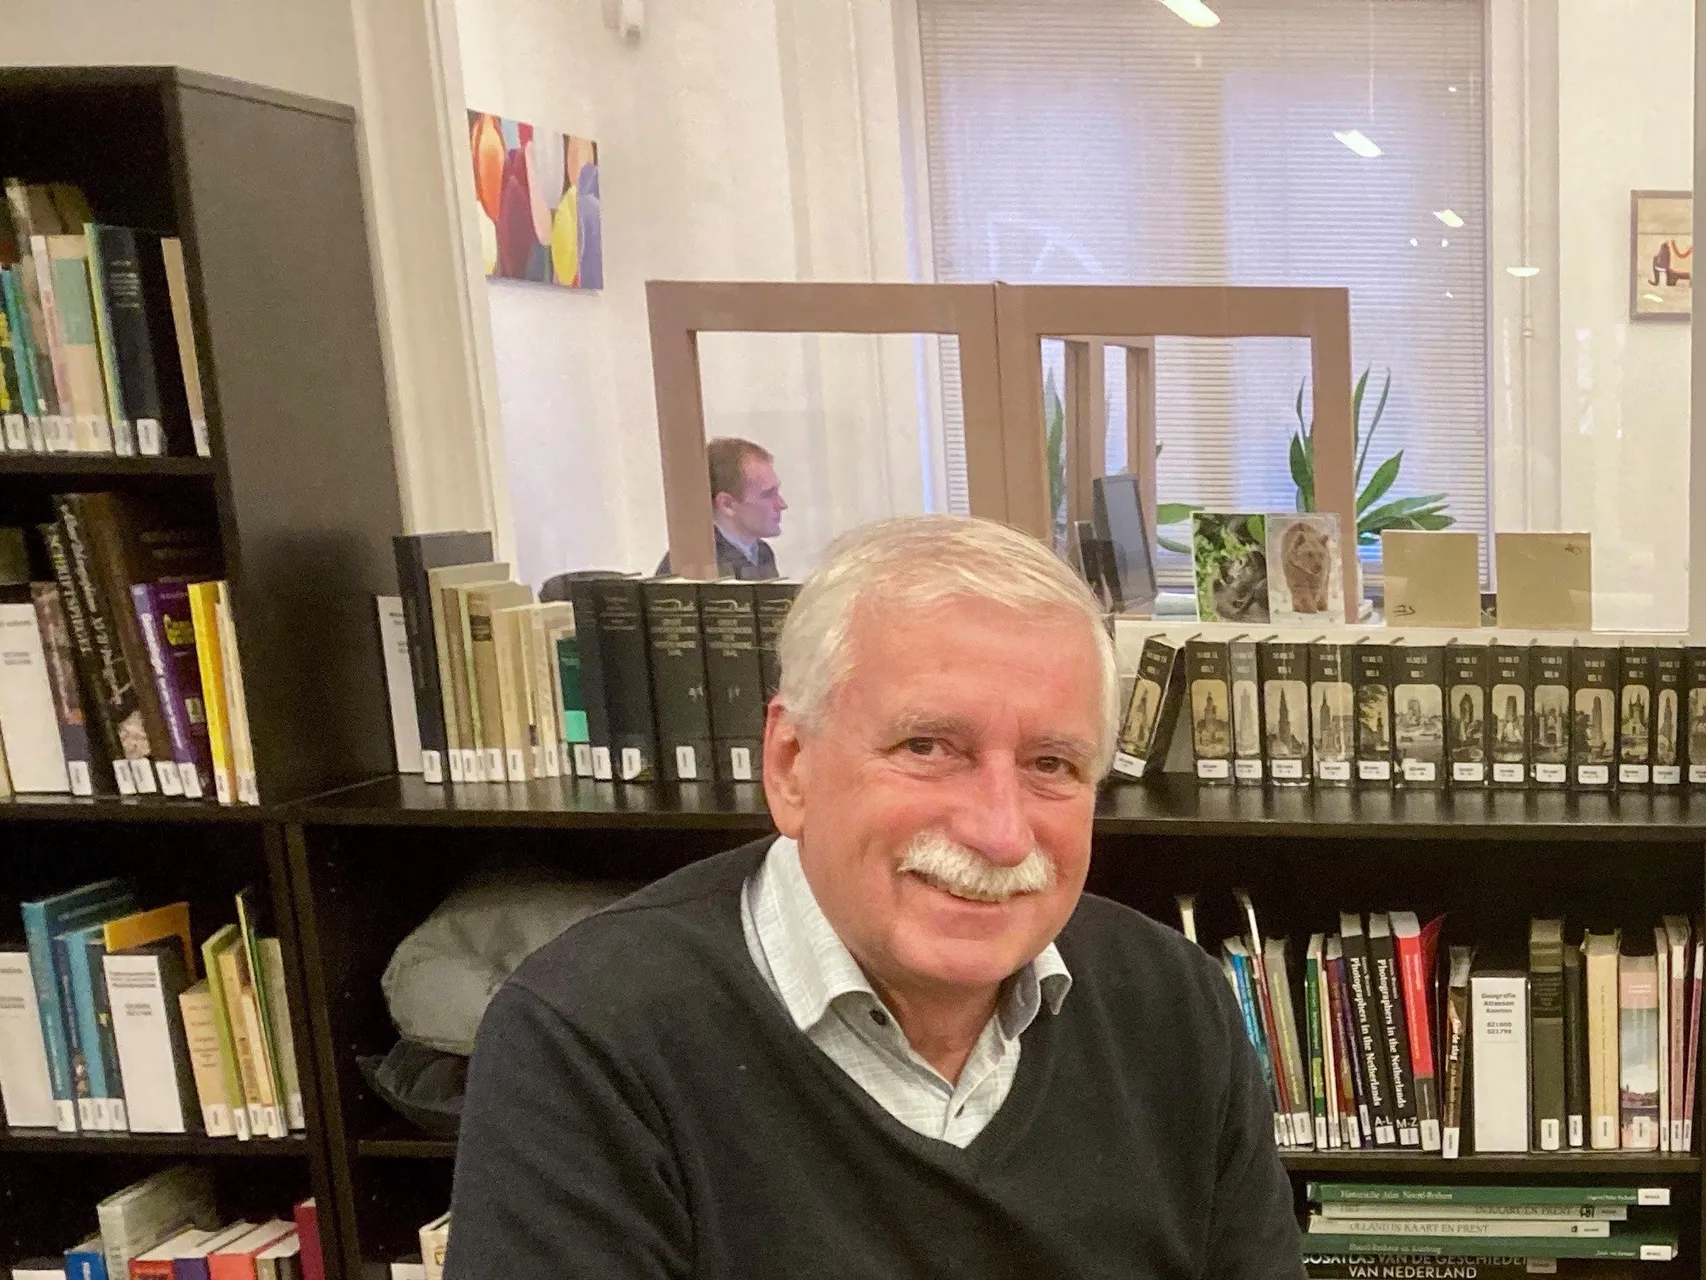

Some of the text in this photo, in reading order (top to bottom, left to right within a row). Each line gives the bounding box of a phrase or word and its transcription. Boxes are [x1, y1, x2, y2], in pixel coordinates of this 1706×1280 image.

[1362, 1024, 1369, 1034] in
[1387, 1026, 1395, 1036] in
[1363, 1036, 1371, 1050] the
[1389, 1038, 1398, 1052] the
[1366, 1053, 1382, 1106] Netherlands
[1391, 1055, 1406, 1108] Netherlands
[1375, 1116, 1392, 1126] A-L
[1396, 1117, 1418, 1128] M-Z
[1349, 1266, 1477, 1279] VAN NEDERLAND
